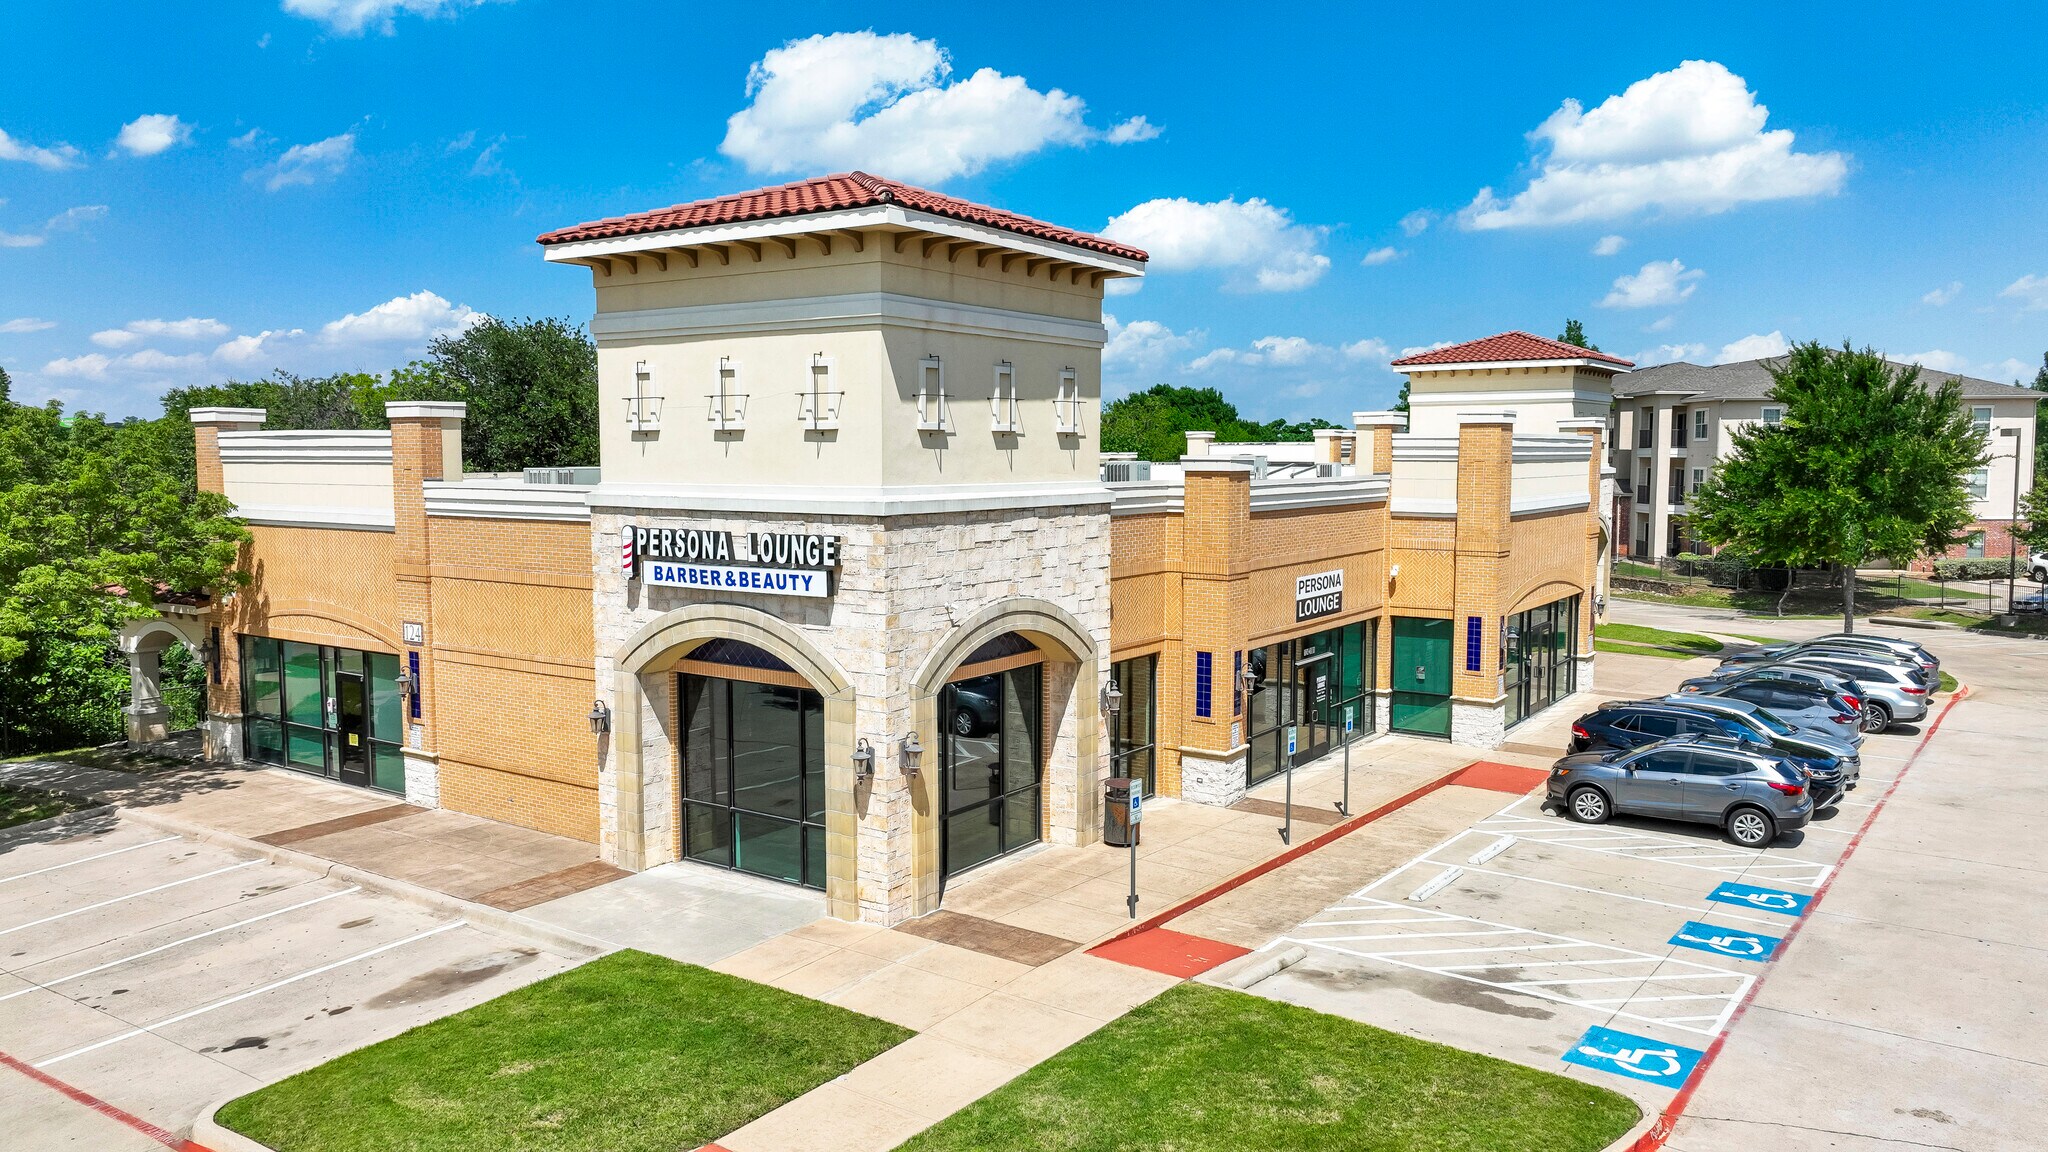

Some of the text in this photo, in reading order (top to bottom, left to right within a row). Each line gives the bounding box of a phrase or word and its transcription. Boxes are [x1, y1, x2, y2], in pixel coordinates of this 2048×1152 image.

[637, 528, 835, 566] PERSONA LOUNGE
[1298, 573, 1341, 595] PERSONA
[1298, 593, 1340, 617] LOUNGE
[405, 624, 421, 641] 124
